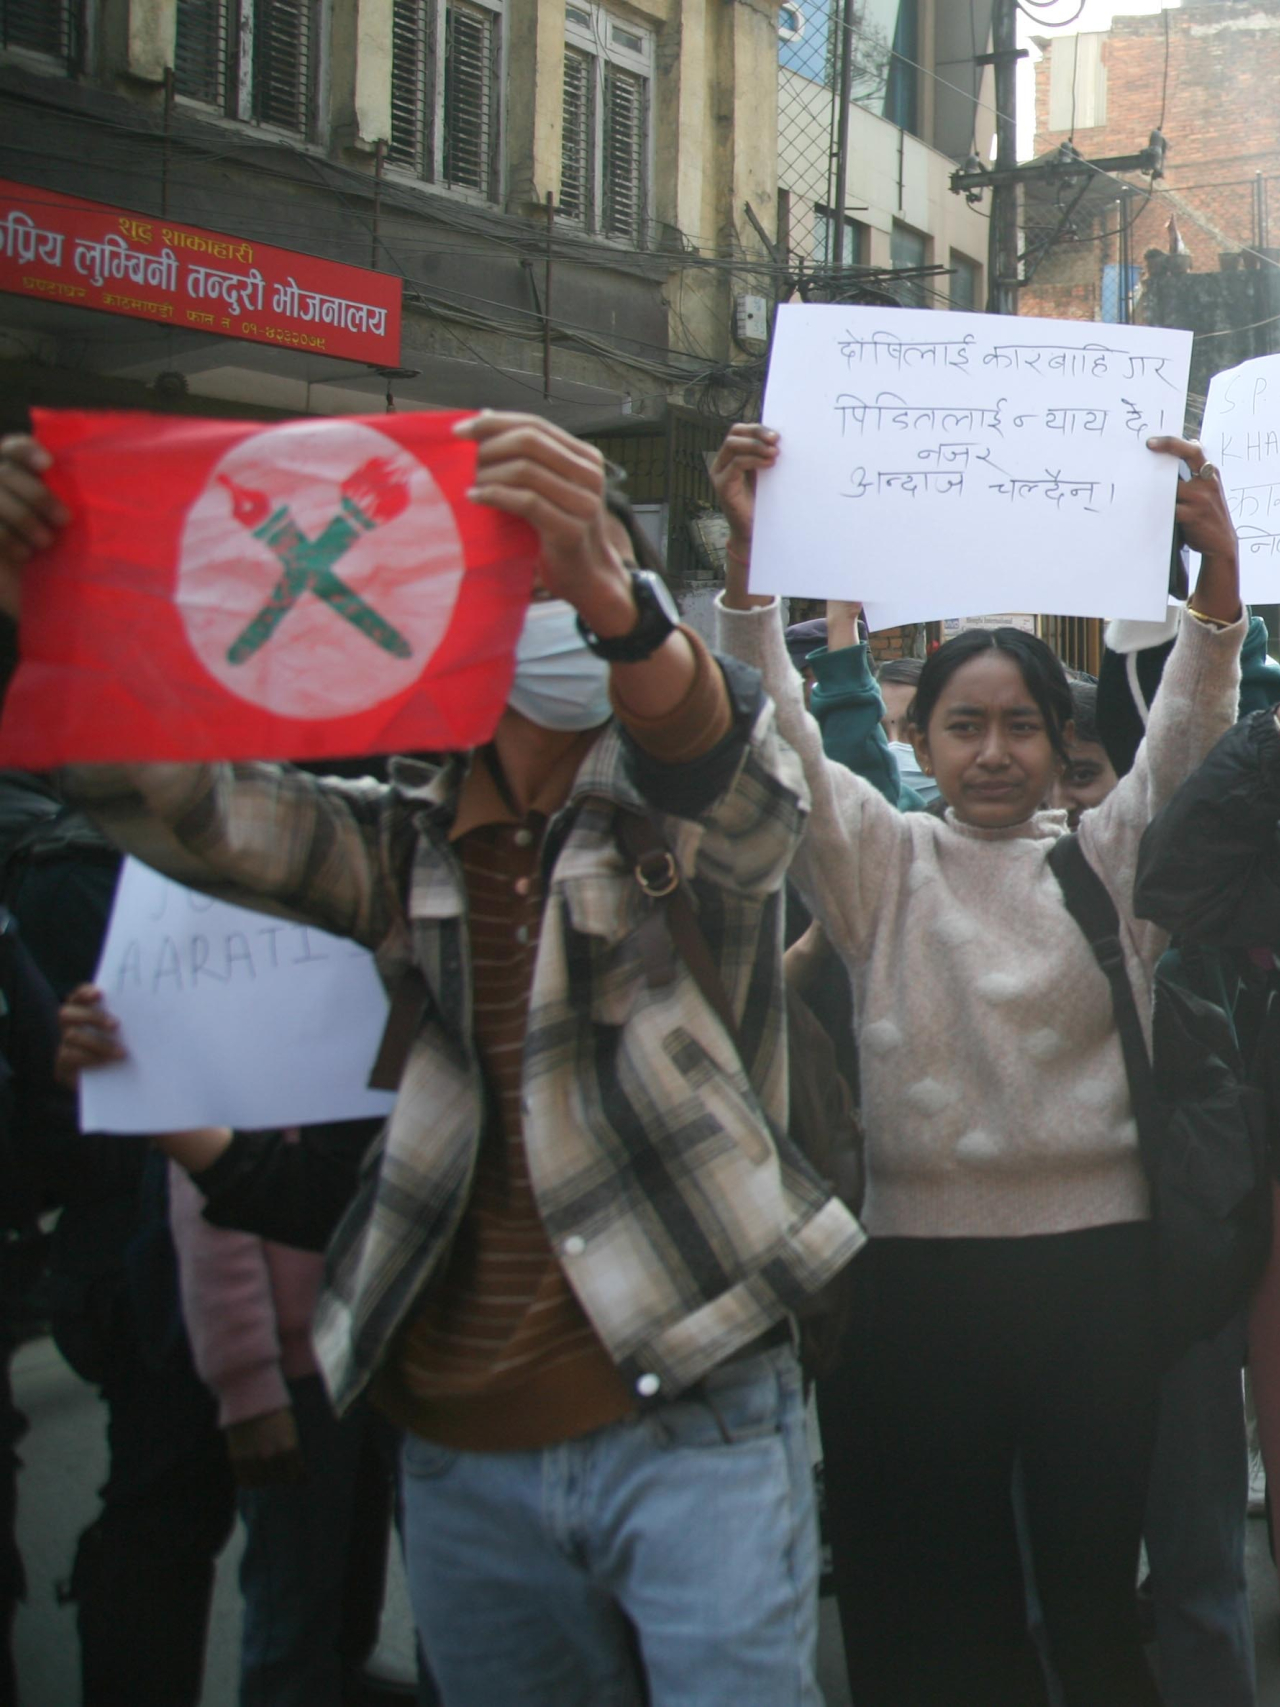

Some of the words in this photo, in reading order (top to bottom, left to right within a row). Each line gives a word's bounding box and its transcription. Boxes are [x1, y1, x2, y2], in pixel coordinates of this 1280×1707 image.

[161, 227, 255, 265] शाकाहारी
[75, 233, 180, 292] लुम्बिनी
[187, 264, 266, 316] तन्दुरी
[271, 276, 388, 337] भोजनालय
[917, 442, 1013, 477] नजर
[839, 466, 966, 498] अन्दाज
[114, 926, 330, 996] AARATI
